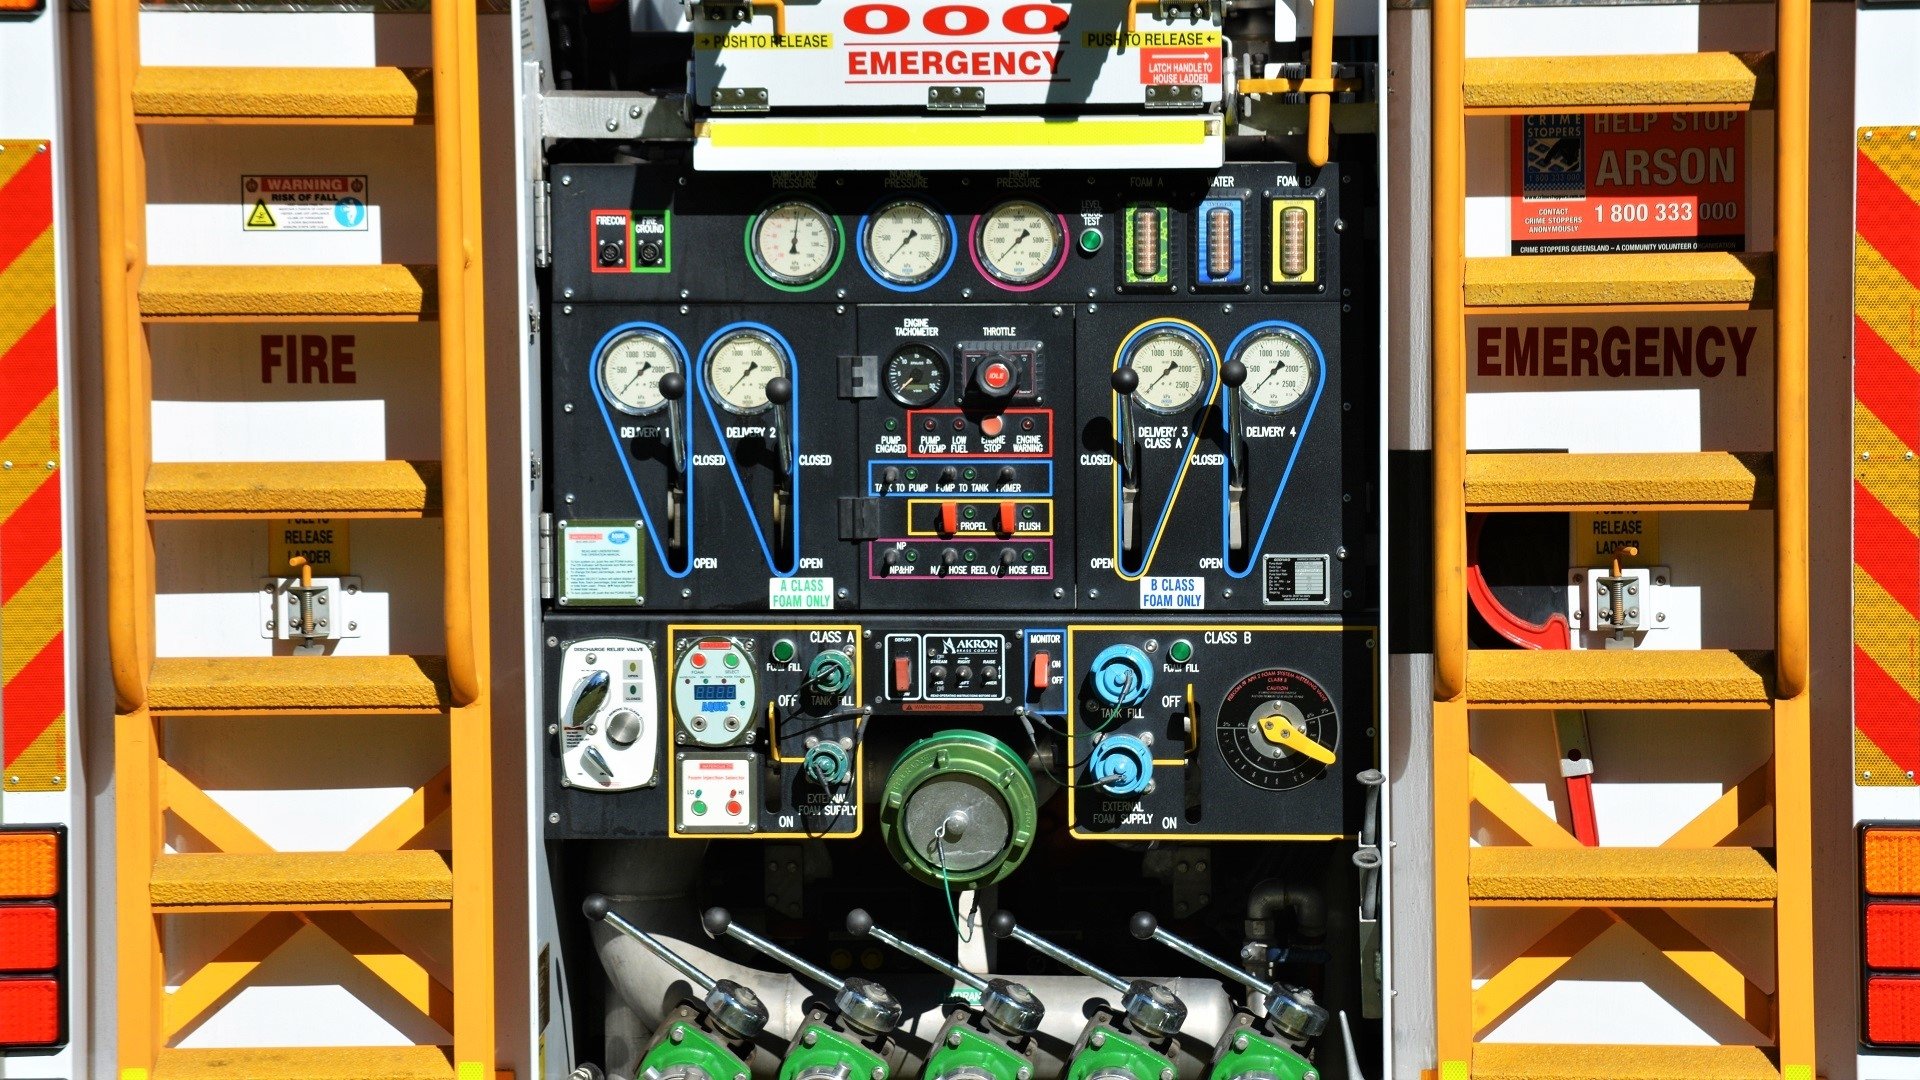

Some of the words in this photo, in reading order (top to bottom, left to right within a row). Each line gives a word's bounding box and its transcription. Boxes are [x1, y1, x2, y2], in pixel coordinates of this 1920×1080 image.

[714, 35, 747, 48] PUSH
[750, 35, 766, 48] TO
[771, 35, 828, 48] RELEASE
[1088, 33, 1121, 47] PUSH
[1123, 33, 1141, 46] TO
[1145, 32, 1204, 46] RELEASE
[849, 50, 1065, 75] EMERGENCY
[1149, 62, 1172, 73] LATCH
[1174, 62, 1202, 73] HANDLE
[1203, 62, 1213, 73] TO
[1153, 74, 1177, 84] HOUSE
[1179, 73, 1209, 84] LADDER
[1527, 114, 1581, 126] CRIME
[1594, 112, 1658, 133] HELP
[1672, 111, 1738, 131] STOP
[1527, 127, 1582, 138] STOPPERS
[1595, 147, 1735, 187] ARSON
[267, 178, 343, 191] WARNING
[771, 179, 817, 189] PRESSURE
[883, 178, 929, 188] PRESSURE
[996, 178, 1041, 188] PRESSURE
[1130, 177, 1153, 187] FOAM
[1157, 177, 1164, 187] A
[1203, 176, 1235, 187] WATER
[1277, 176, 1303, 187] FOAM
[1304, 177, 1312, 187] B
[272, 193, 295, 202] RISK
[298, 193, 311, 202] OF
[314, 193, 339, 202] FALL
[1538, 208, 1569, 216] CONTACT
[1594, 204, 1604, 222] 1
[1610, 204, 1649, 223] 800
[1654, 203, 1693, 221] 333
[1699, 202, 1738, 220] 000
[596, 215, 626, 226] FIRECOM
[642, 216, 658, 225] FIRE
[1084, 216, 1101, 226] TEST
[1524, 217, 1546, 225] CRIME
[1547, 216, 1582, 224] STOPPERS
[635, 224, 664, 234] GROUND
[1528, 225, 1579, 234] ANONYMOUSLY
[1519, 245, 1538, 253] CRIME
[1539, 244, 1570, 253] STOPPERS
[1570, 243, 1609, 252] QUEENSLAND
[1616, 243, 1621, 251] A
[1621, 242, 1656, 251] COMMUNITY
[1657, 241, 1691, 250] VOLUNTEER
[904, 318, 930, 327] ENGINE
[895, 327, 939, 336] TACHOMETER
[982, 327, 1017, 336] THROTTLE
[1259, 349, 1272, 357] 1000
[1277, 349, 1290, 357] 1500
[1477, 326, 1758, 378] EMERGENCY
[261, 335, 356, 384] FIRE
[1249, 365, 1261, 373] 500
[1281, 380, 1296, 388] 2500
[621, 427, 660, 438] DELIVERY
[664, 427, 670, 438] 1
[726, 427, 766, 438] DELIVERY
[769, 427, 777, 438] 2
[1138, 426, 1177, 438] DELIVERY
[1181, 426, 1189, 437] 3
[1246, 426, 1286, 438] DELIVERY
[1289, 426, 1297, 437] 4
[881, 435, 902, 445] PUMP
[920, 435, 942, 445] PUMP
[951, 435, 967, 445] LOW
[980, 435, 1007, 445] ENGINE
[1016, 435, 1042, 445] ENGINE
[1144, 438, 1171, 449] CLASS
[1175, 438, 1183, 449] A
[875, 444, 907, 454] ENGAGED
[918, 444, 947, 454] O/TEMP
[951, 444, 969, 454] FUEL
[983, 444, 1003, 453] STOP
[1012, 444, 1044, 453] WARNING
[692, 454, 726, 466] CLOSED
[799, 454, 832, 466] CLOSED
[1080, 454, 1114, 466] CLOSED
[1190, 454, 1224, 466] CLOSED
[896, 483, 906, 492] TO
[908, 483, 930, 492] PUMP
[935, 483, 955, 492] PUMP
[958, 483, 968, 492] TO
[971, 483, 989, 492] TANK
[960, 521, 988, 531] PROPEL
[1018, 521, 1041, 531] FLUSH
[1593, 520, 1642, 534] RELEASE
[285, 530, 334, 544] RELEASE
[896, 541, 907, 550] NP
[693, 558, 718, 569] OPEN
[800, 558, 824, 569] OPEN
[1090, 558, 1115, 569] OPEN
[1199, 558, 1224, 569] OPEN
[889, 565, 915, 575] NP&HP
[948, 565, 968, 575] HOSE
[970, 565, 988, 575] REEL
[1008, 565, 1028, 575] HOSE
[1030, 565, 1049, 575] REEL
[780, 580, 788, 590] A
[791, 579, 825, 591] CLASS
[1151, 579, 1158, 591] B
[1161, 579, 1195, 591] CLASS
[773, 594, 802, 607] FOAM
[804, 594, 832, 607] ONLY
[1143, 594, 1174, 607] FOAM
[1176, 594, 1203, 607] ONLY
[810, 631, 842, 644] CLASS
[846, 631, 855, 644] A
[1030, 634, 1061, 647] MONITOR
[1204, 631, 1238, 644] CLASS
[1243, 631, 1253, 644] B
[956, 639, 998, 649] AKRON
[788, 662, 803, 672] FILL
[1051, 662, 1061, 672] ON
[1163, 663, 1183, 673] FOAM
[1185, 663, 1200, 673] FILL
[1050, 678, 1064, 688] OFF
[777, 695, 798, 707] OFF
[810, 695, 832, 707] TANK
[836, 695, 854, 707] FILL
[1161, 695, 1183, 707] OFF
[1100, 708, 1123, 719] TANK
[1126, 708, 1145, 719] FILL
[823, 804, 858, 816] SUPPLY
[1102, 801, 1144, 812] EXTERNAL
[779, 815, 794, 828] ON
[1093, 813, 1117, 825] FOAM
[1120, 813, 1153, 825] SUPPLY
[1161, 816, 1177, 829] ON
